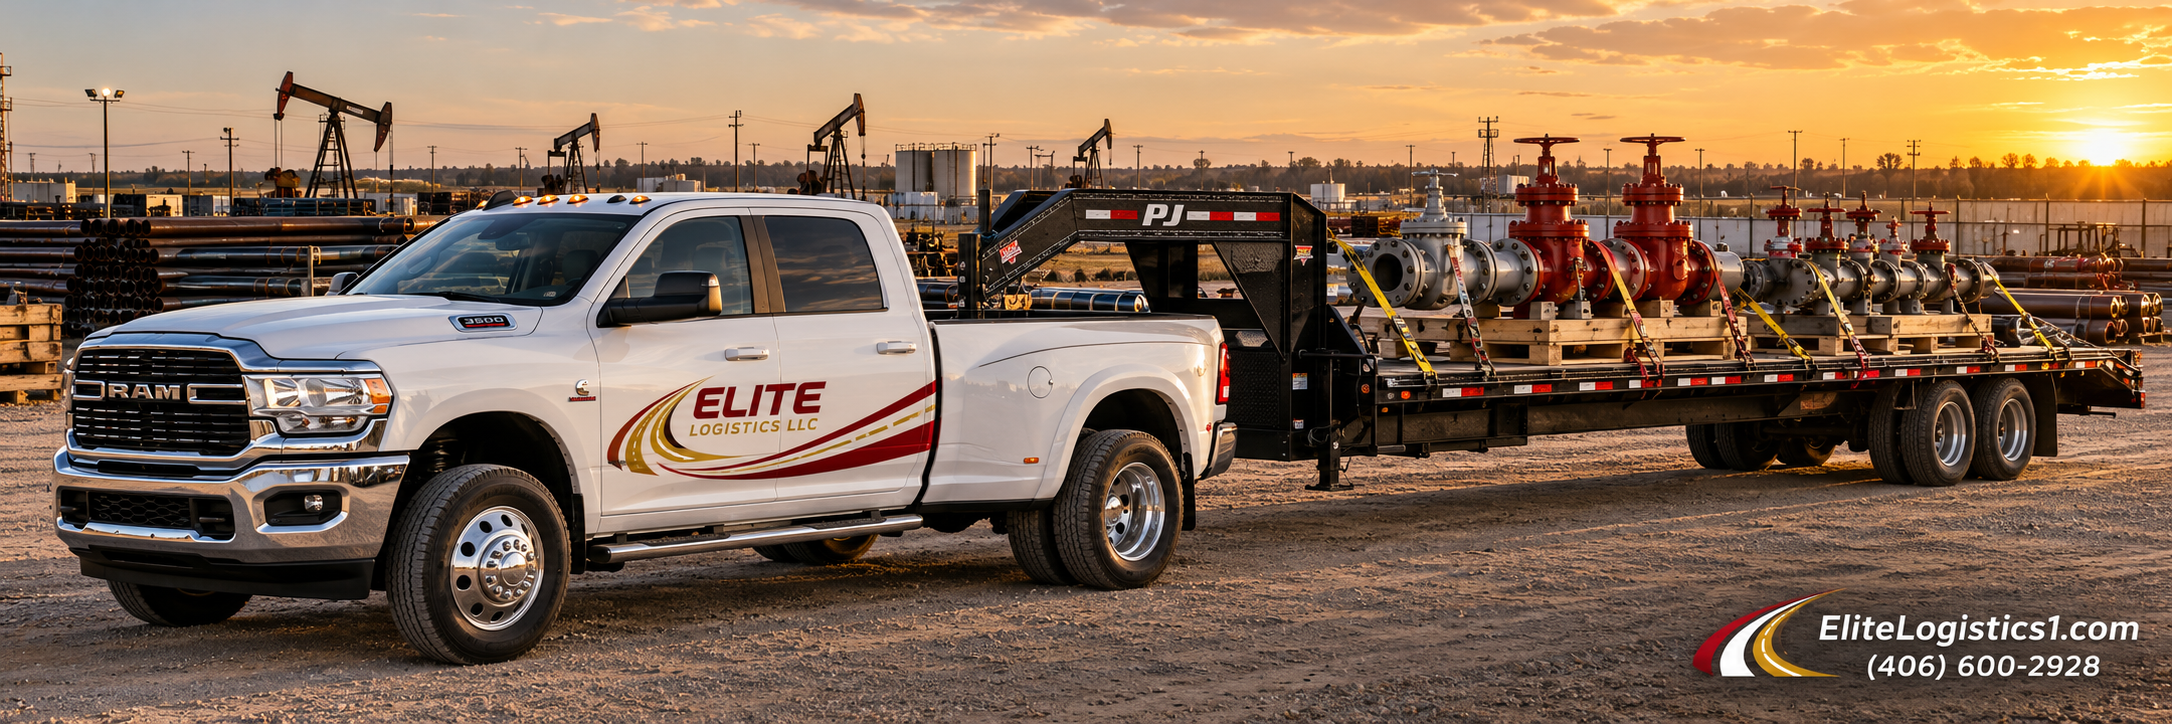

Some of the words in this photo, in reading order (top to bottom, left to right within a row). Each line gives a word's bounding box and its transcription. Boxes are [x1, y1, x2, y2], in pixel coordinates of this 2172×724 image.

[1142, 204, 1184, 226] PJ
[464, 316, 504, 324] 3500
[108, 383, 180, 400] RAM
[693, 381, 827, 419] ELITE
[689, 420, 781, 437] LOGISTICS
[787, 418, 818, 431] LLC
